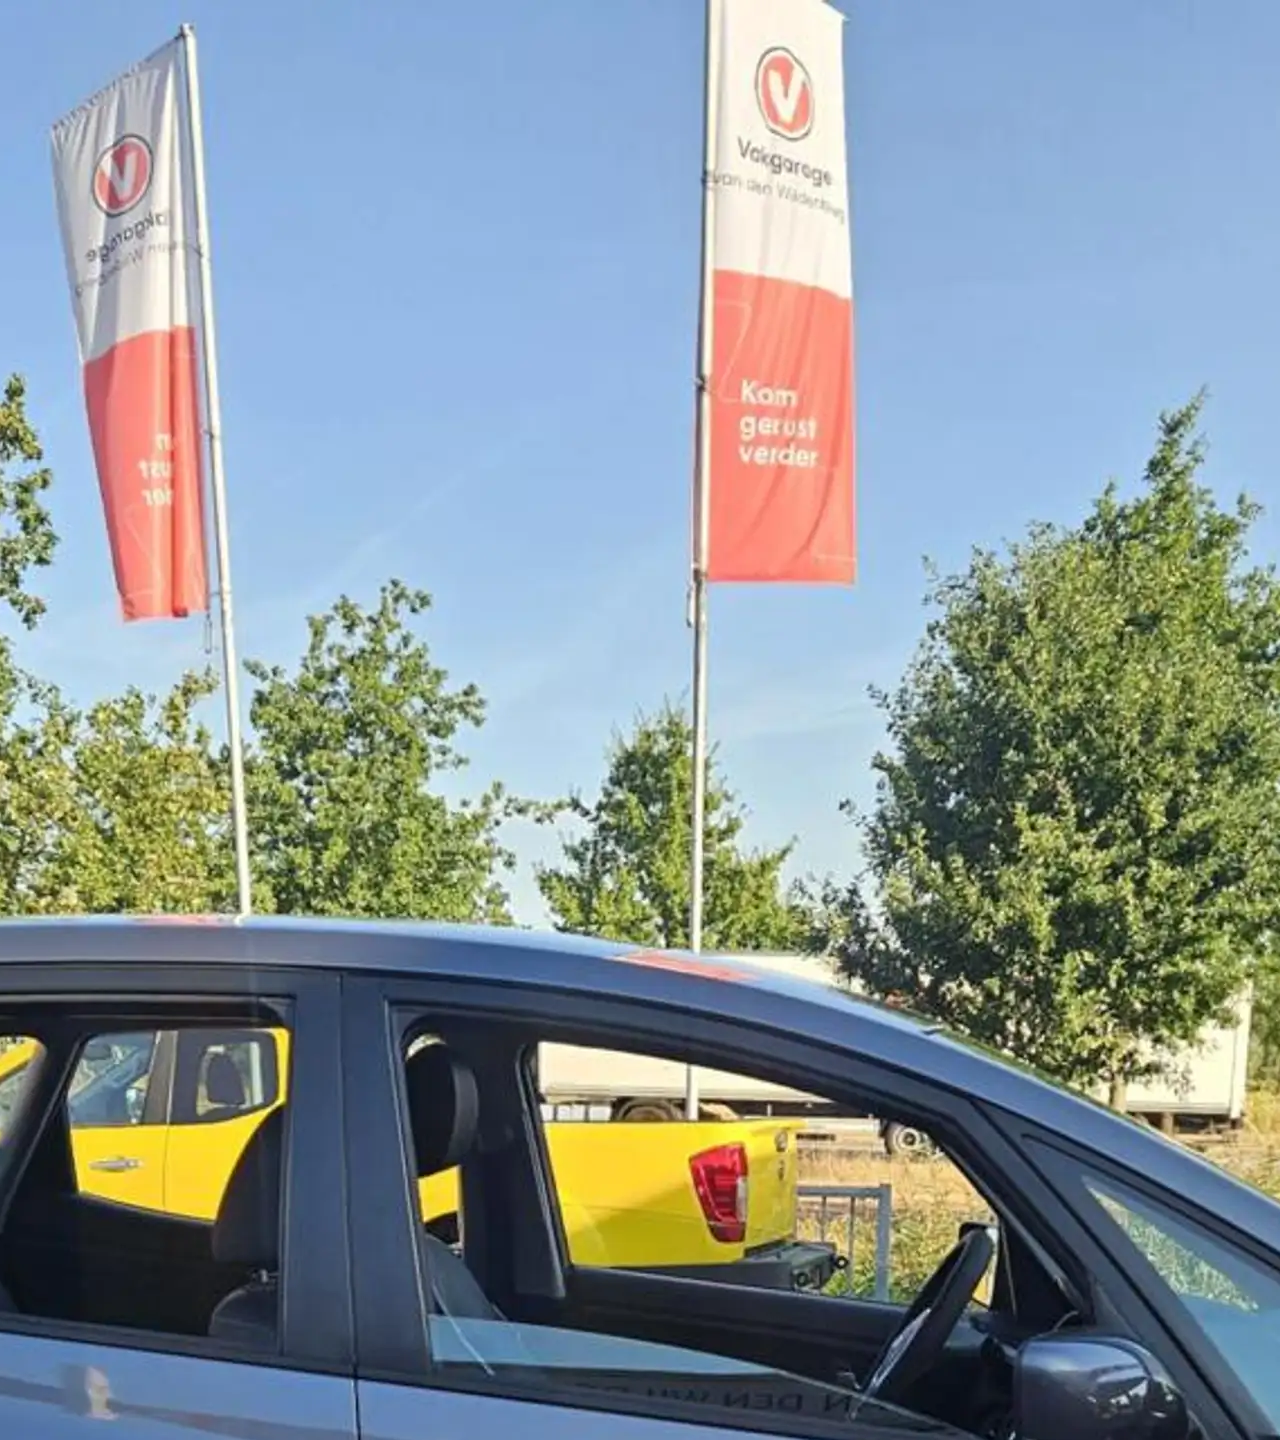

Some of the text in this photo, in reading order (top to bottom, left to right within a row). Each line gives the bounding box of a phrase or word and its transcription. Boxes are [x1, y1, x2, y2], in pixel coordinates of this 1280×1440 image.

[737, 136, 833, 187] Vakgarage
[740, 378, 797, 409] Kom
[738, 415, 817, 442] gerust
[738, 442, 819, 469] verder
